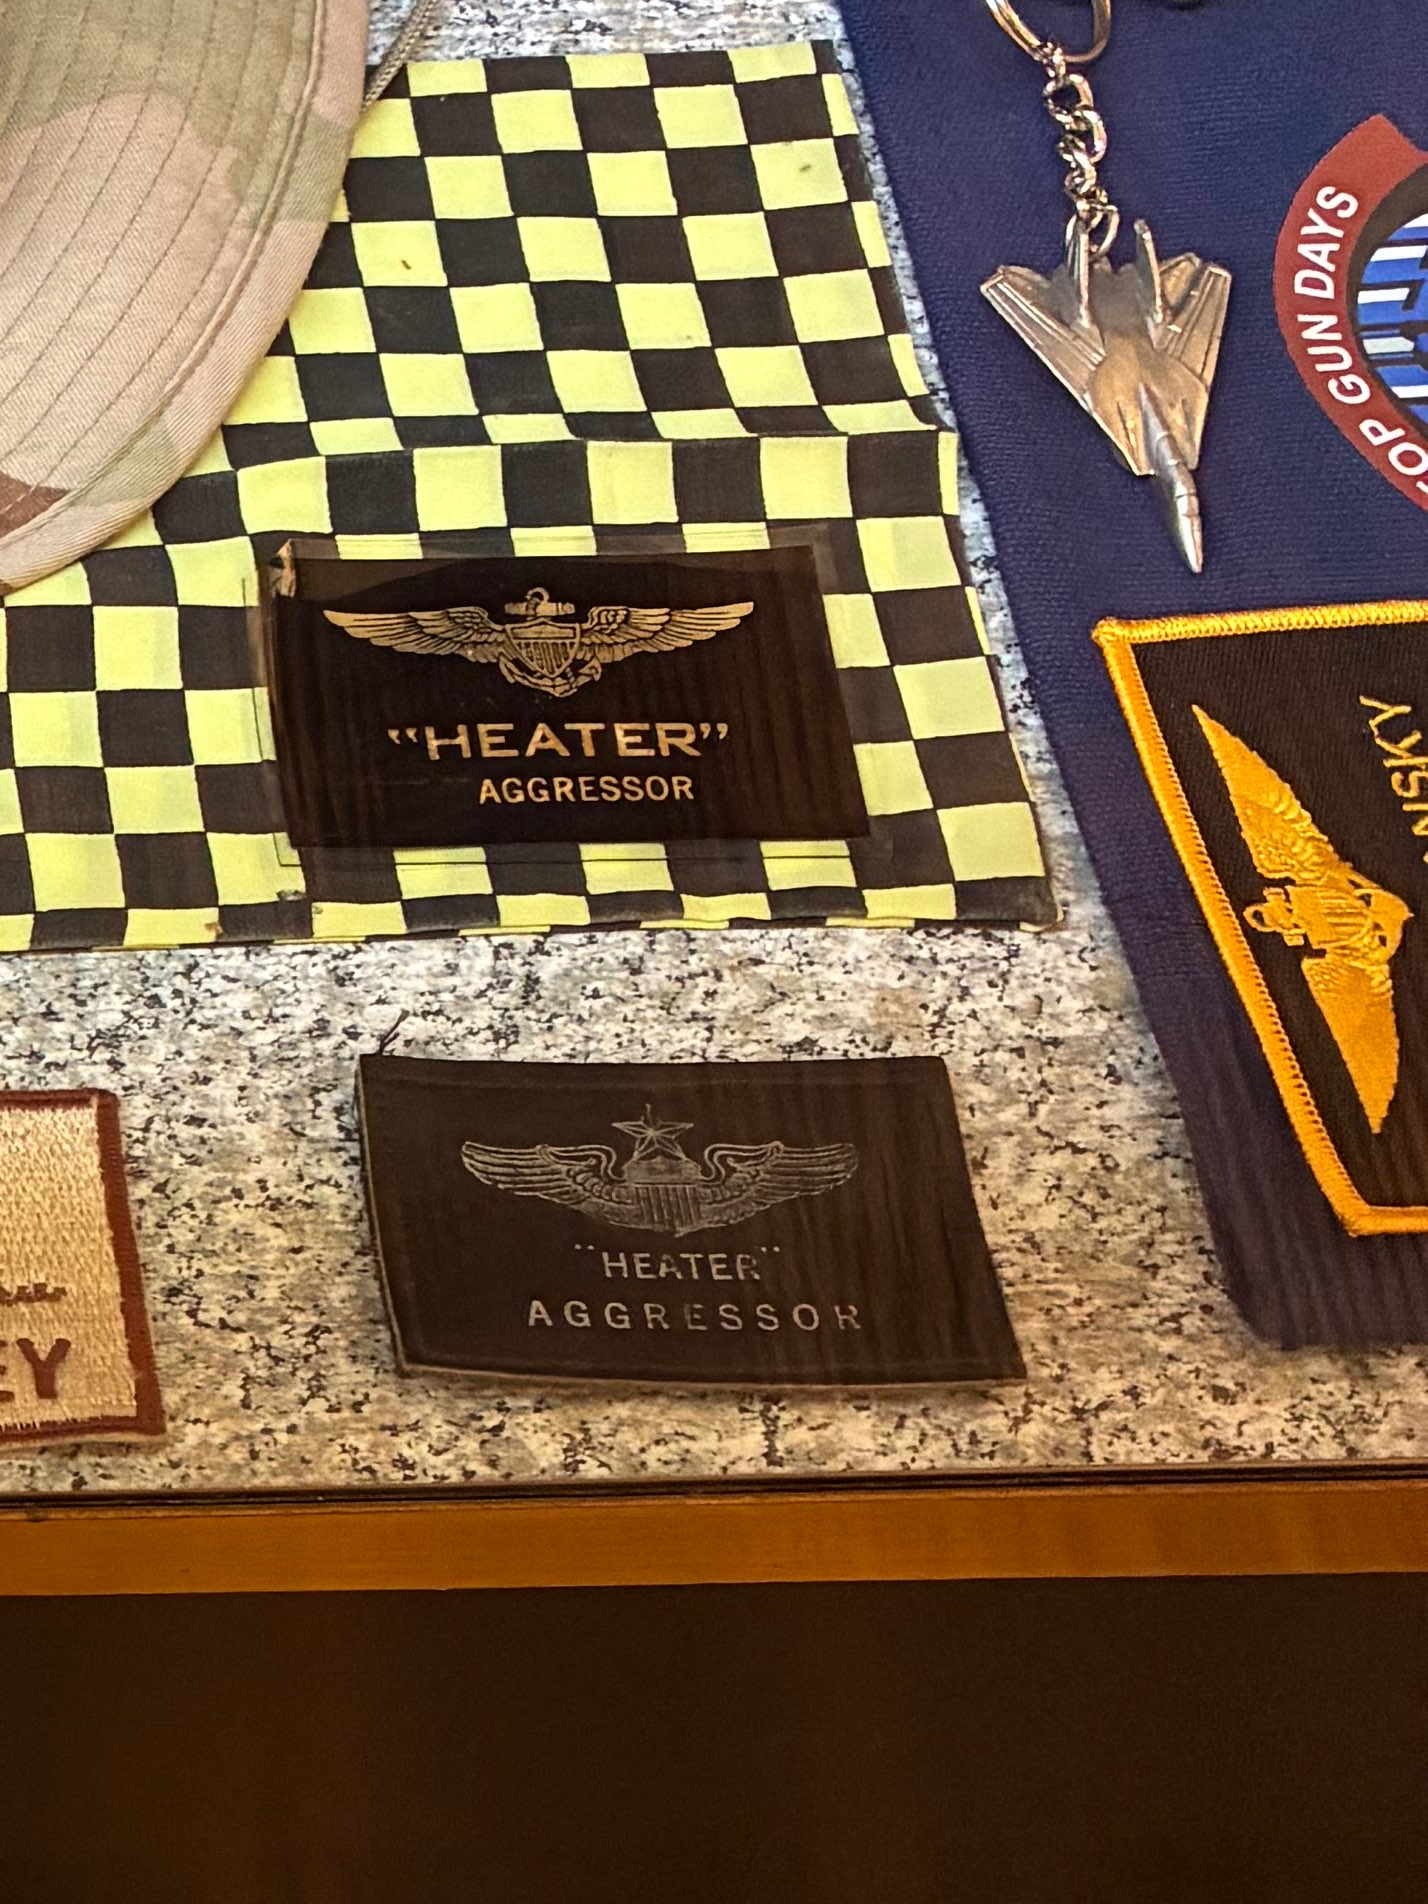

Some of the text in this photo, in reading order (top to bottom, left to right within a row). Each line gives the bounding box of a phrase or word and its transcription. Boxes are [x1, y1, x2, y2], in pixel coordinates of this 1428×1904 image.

[1294, 186, 1428, 495] OP GUN DAYS
[387, 722, 728, 761] "HEATER"
[480, 774, 695, 806] AGGRESSOR
[574, 1243, 780, 1281] "HEATER"
[527, 1298, 863, 1332] AGGRESSOR
